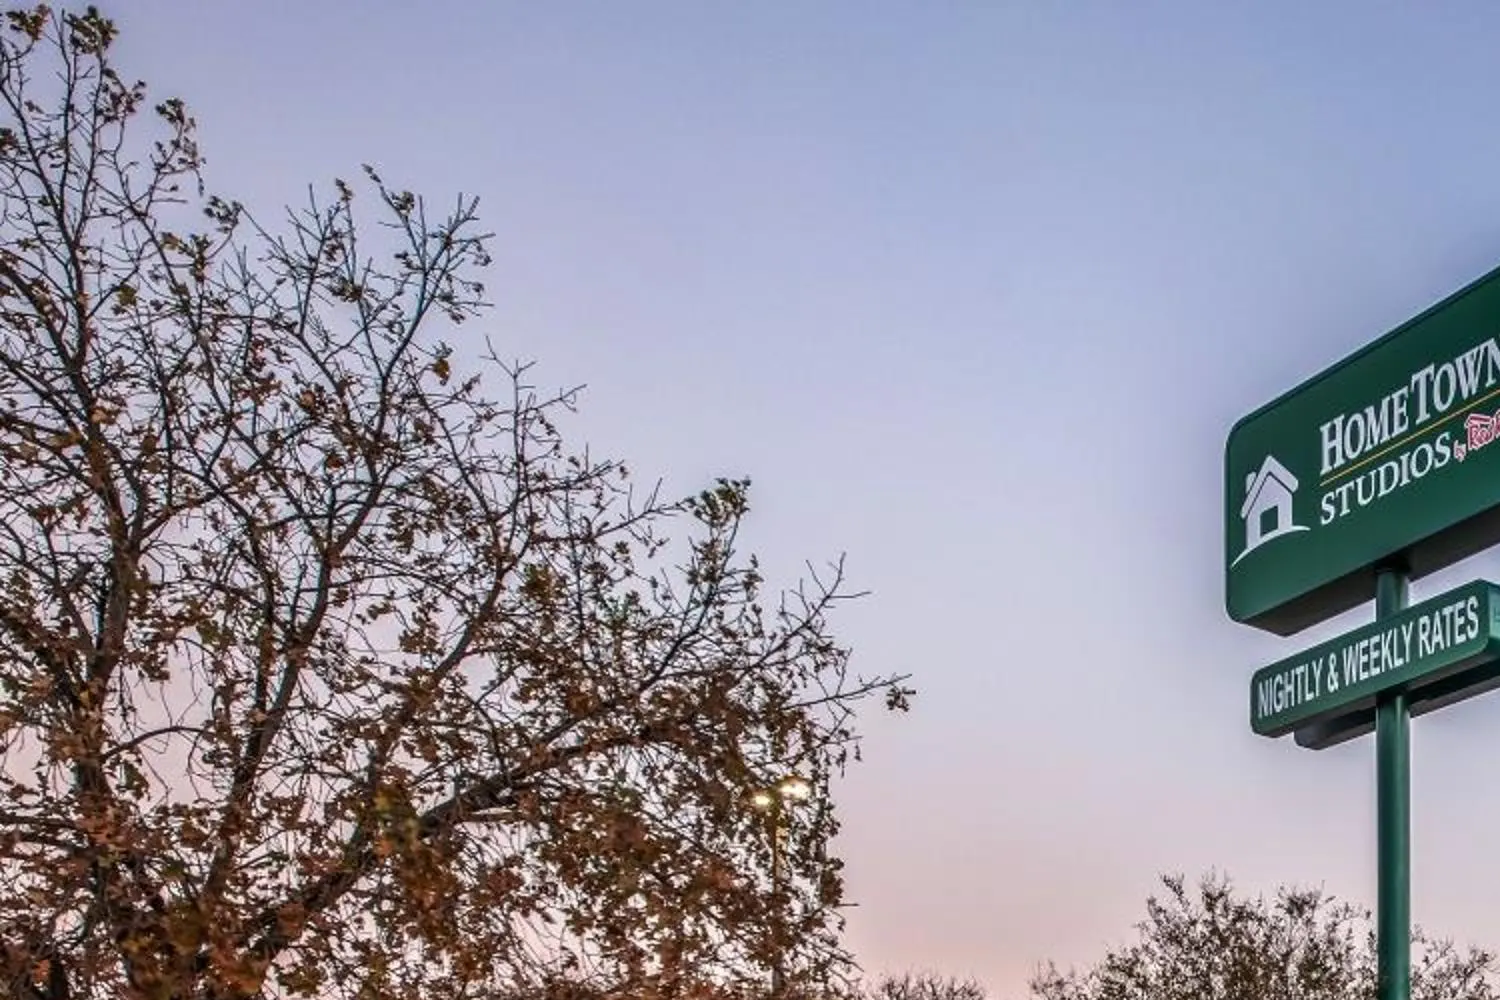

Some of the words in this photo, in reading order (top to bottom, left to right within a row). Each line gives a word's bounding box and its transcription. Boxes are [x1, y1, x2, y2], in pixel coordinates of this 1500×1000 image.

[1320, 432, 1451, 526] STUDIOS
[1453, 439, 1467, 463] by
[1257, 657, 1324, 719] NIGHTLY
[1327, 652, 1339, 693] &
[1342, 620, 1414, 687] WEEKLY
[1418, 595, 1480, 660] RATES
